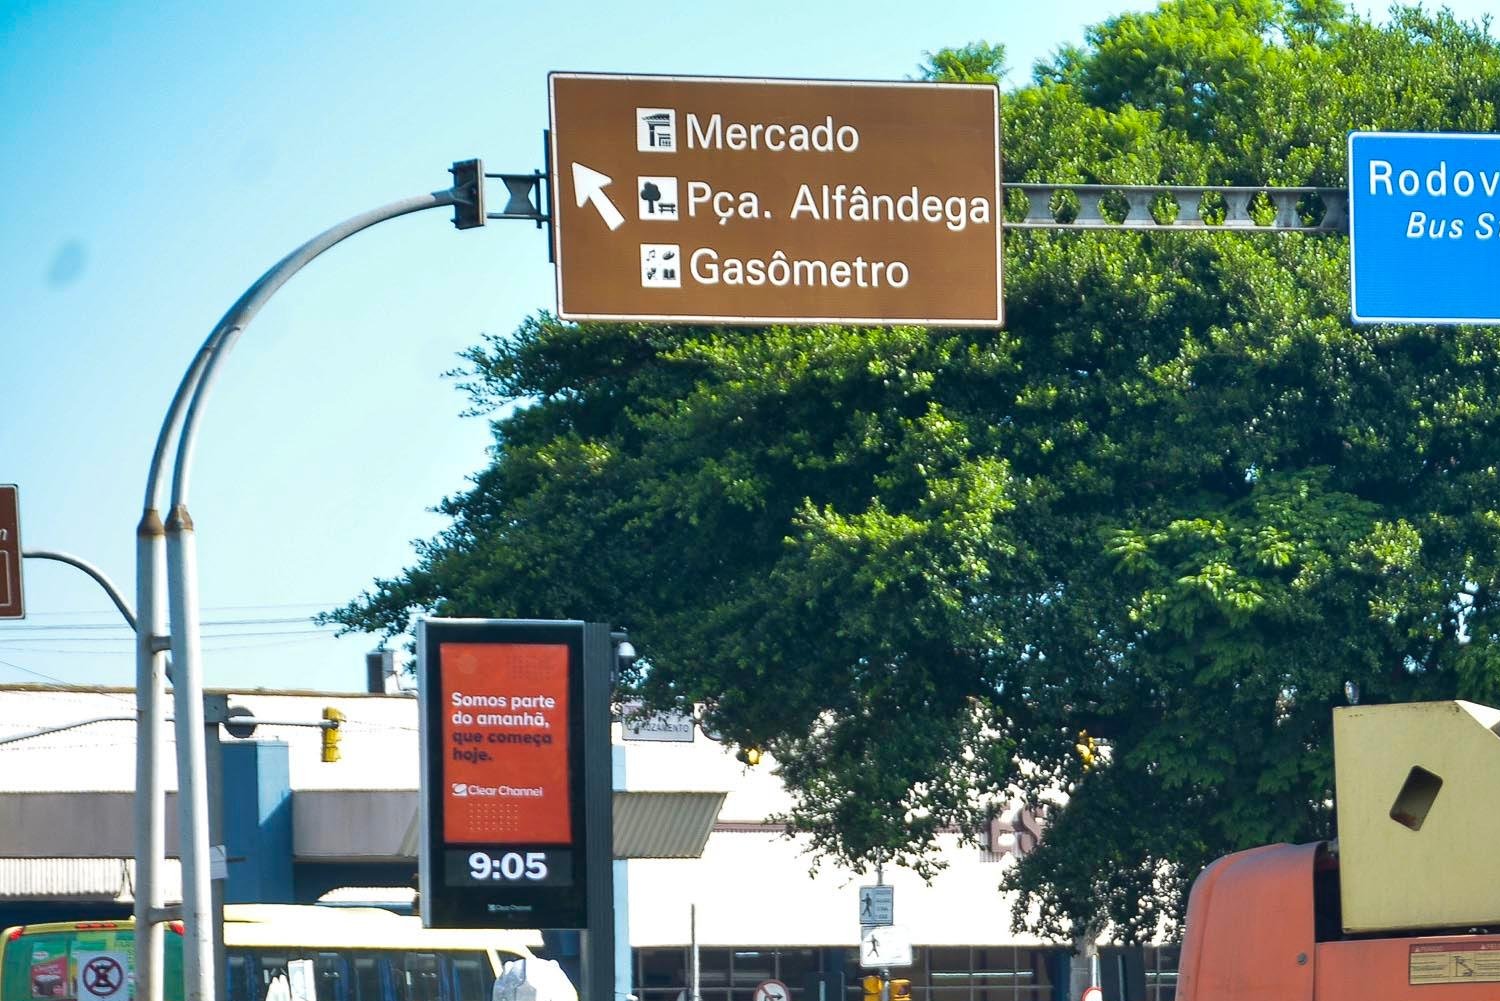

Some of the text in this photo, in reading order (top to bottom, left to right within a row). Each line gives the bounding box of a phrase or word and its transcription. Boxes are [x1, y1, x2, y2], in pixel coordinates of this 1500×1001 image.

[685, 114, 860, 152] Mercado
[686, 181, 990, 231] Pça. Alfândega
[1407, 211, 1464, 239] Bus
[689, 247, 909, 288] Gasômetro
[452, 692, 556, 710] Somos parte
[452, 710, 550, 728] do amanhã,
[452, 732, 552, 747] que começa
[452, 747, 493, 764] hoje.
[468, 784, 544, 797] Clear Channel
[468, 852, 548, 880] 9:05
